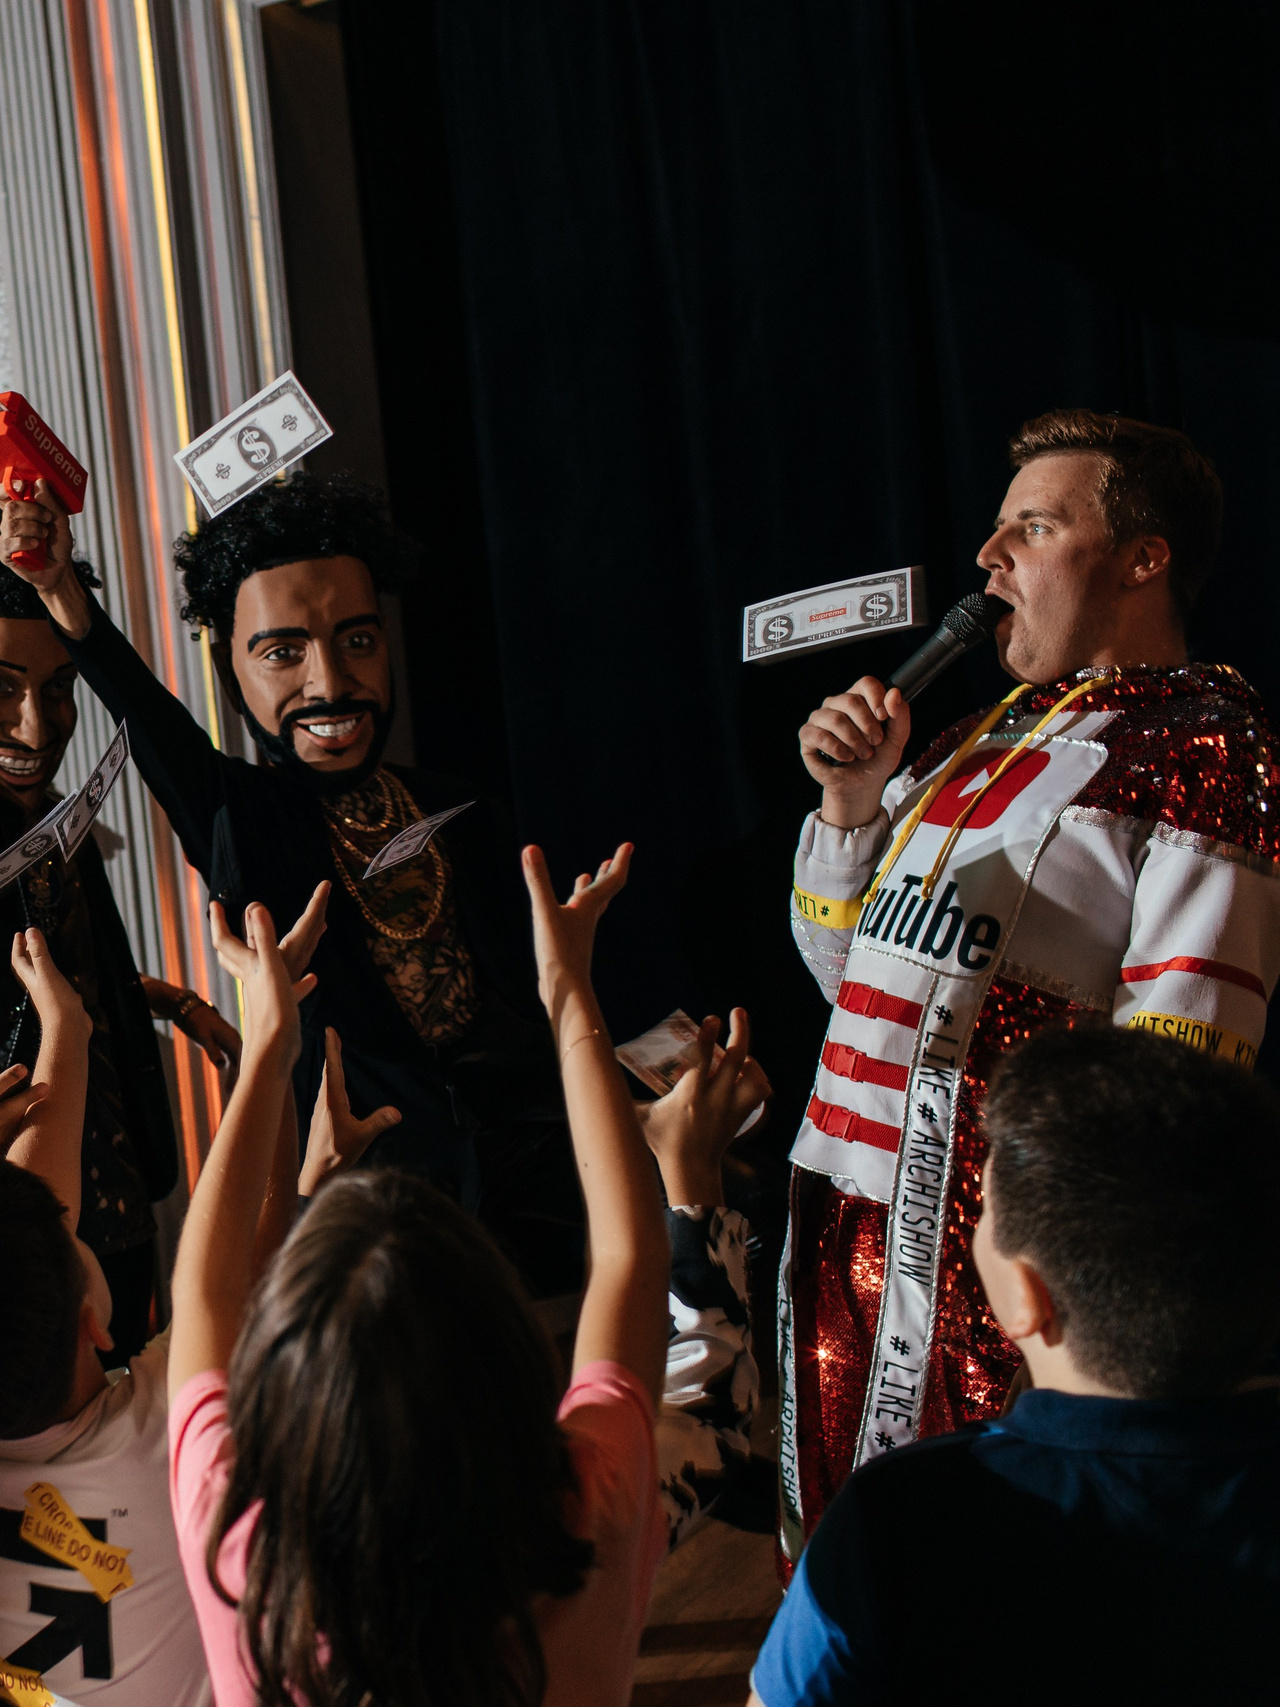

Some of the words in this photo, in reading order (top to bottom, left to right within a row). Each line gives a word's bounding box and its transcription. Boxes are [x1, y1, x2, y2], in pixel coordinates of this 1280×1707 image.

[24, 413, 84, 488] Supreme
[255, 458, 286, 483] SUPREME
[810, 608, 846, 622] Supreme
[807, 627, 847, 643] SUPREME
[34, 1520, 67, 1552] LINE
[66, 1538, 92, 1562] DO
[91, 1550, 127, 1575] NOT
